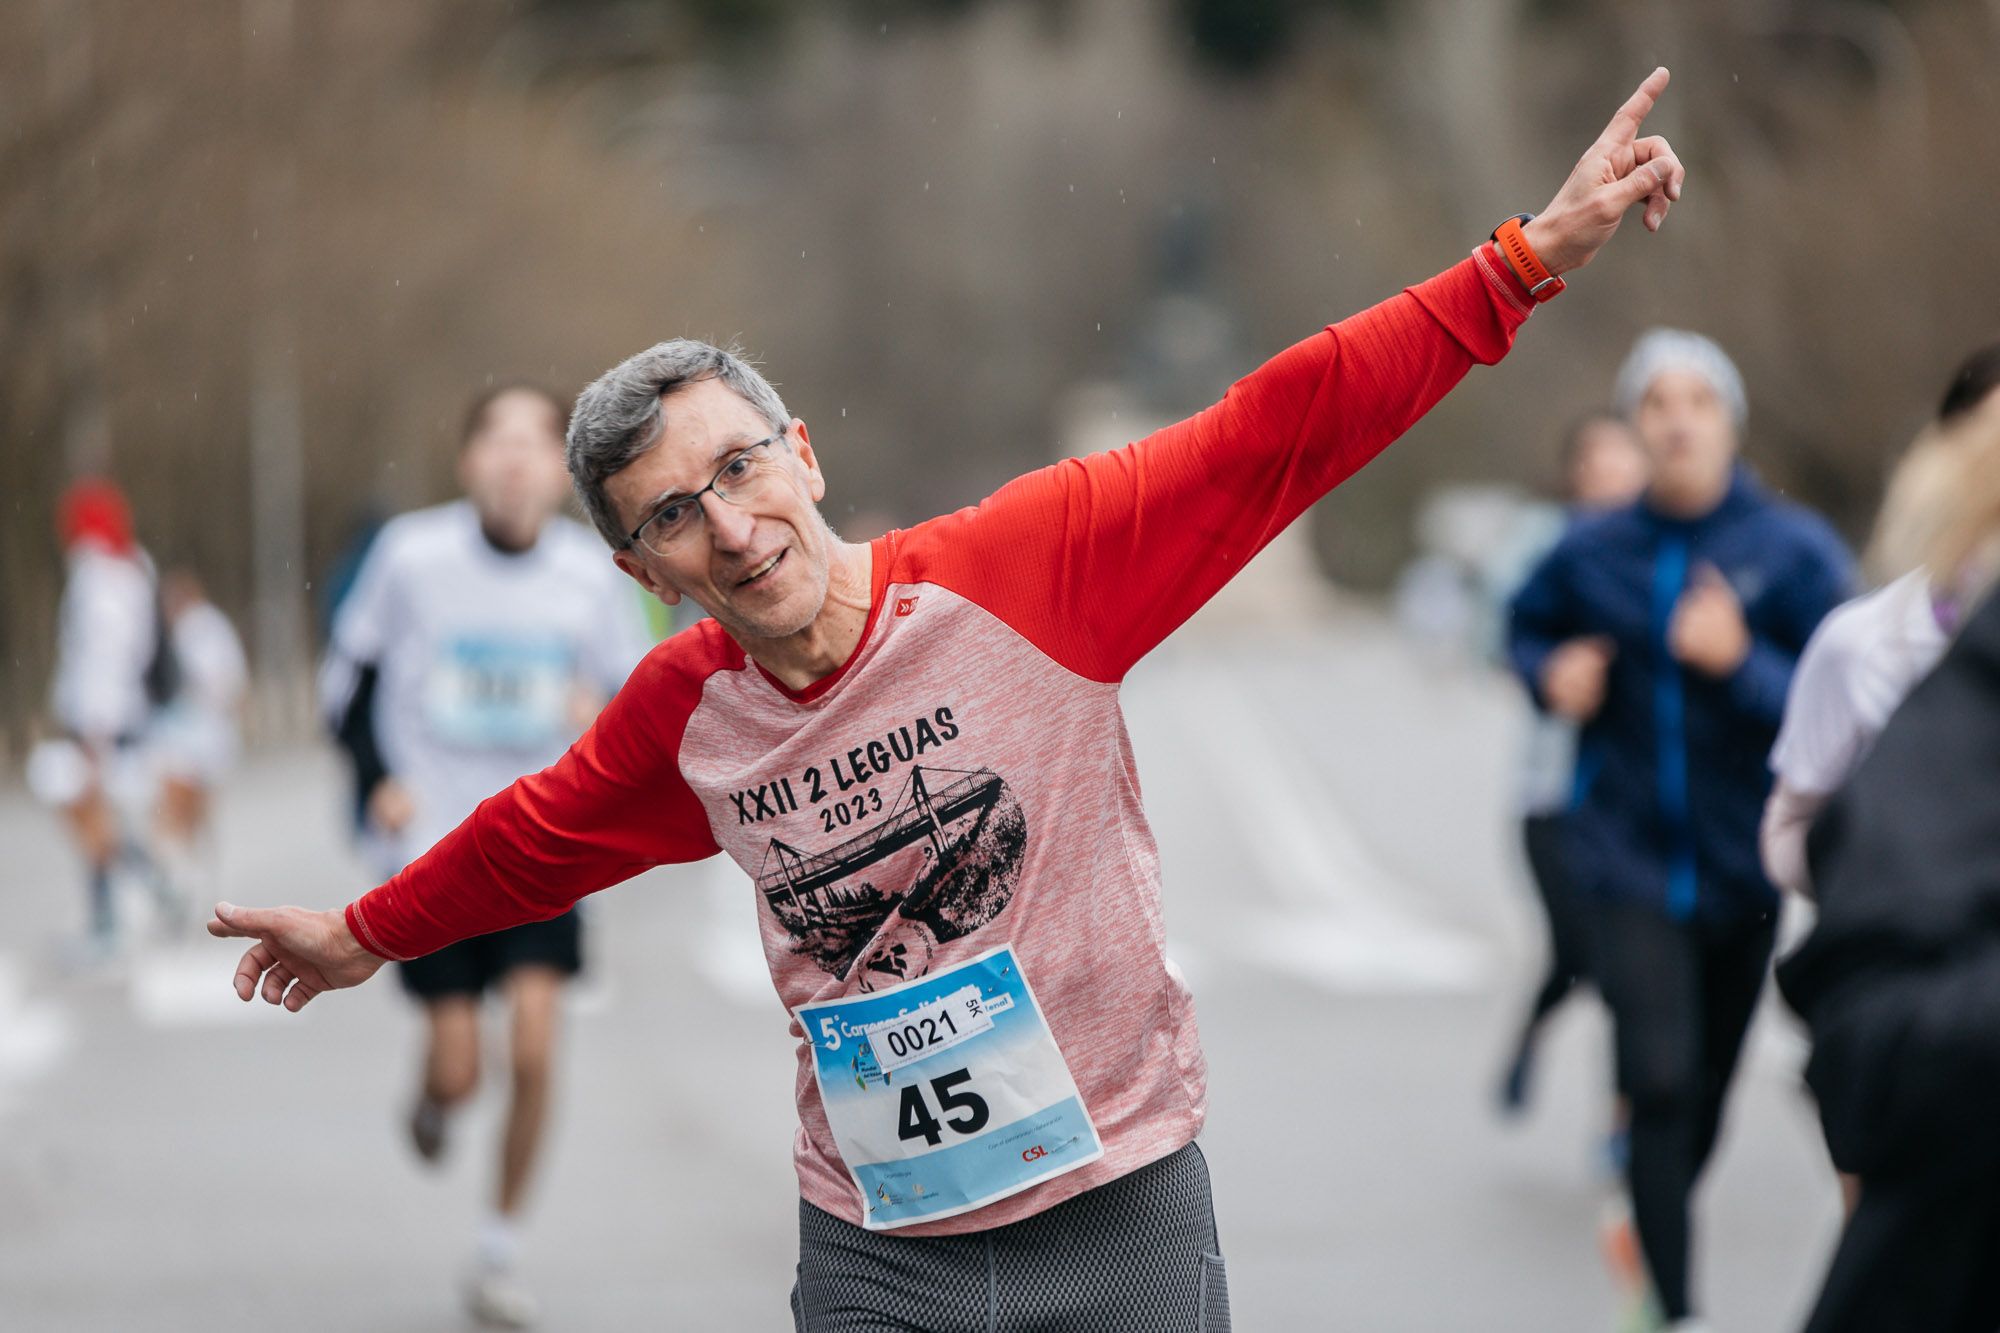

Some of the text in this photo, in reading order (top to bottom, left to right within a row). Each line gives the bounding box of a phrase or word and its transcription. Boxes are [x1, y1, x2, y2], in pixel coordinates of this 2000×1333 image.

[729, 707, 959, 825] XXII 2 LEGUAS
[819, 788, 883, 833] 2023
[966, 999, 983, 1018] 5K
[887, 1009, 957, 1057] 0021
[898, 1067, 989, 1147] 45
[1022, 1145, 1048, 1162] CSL
